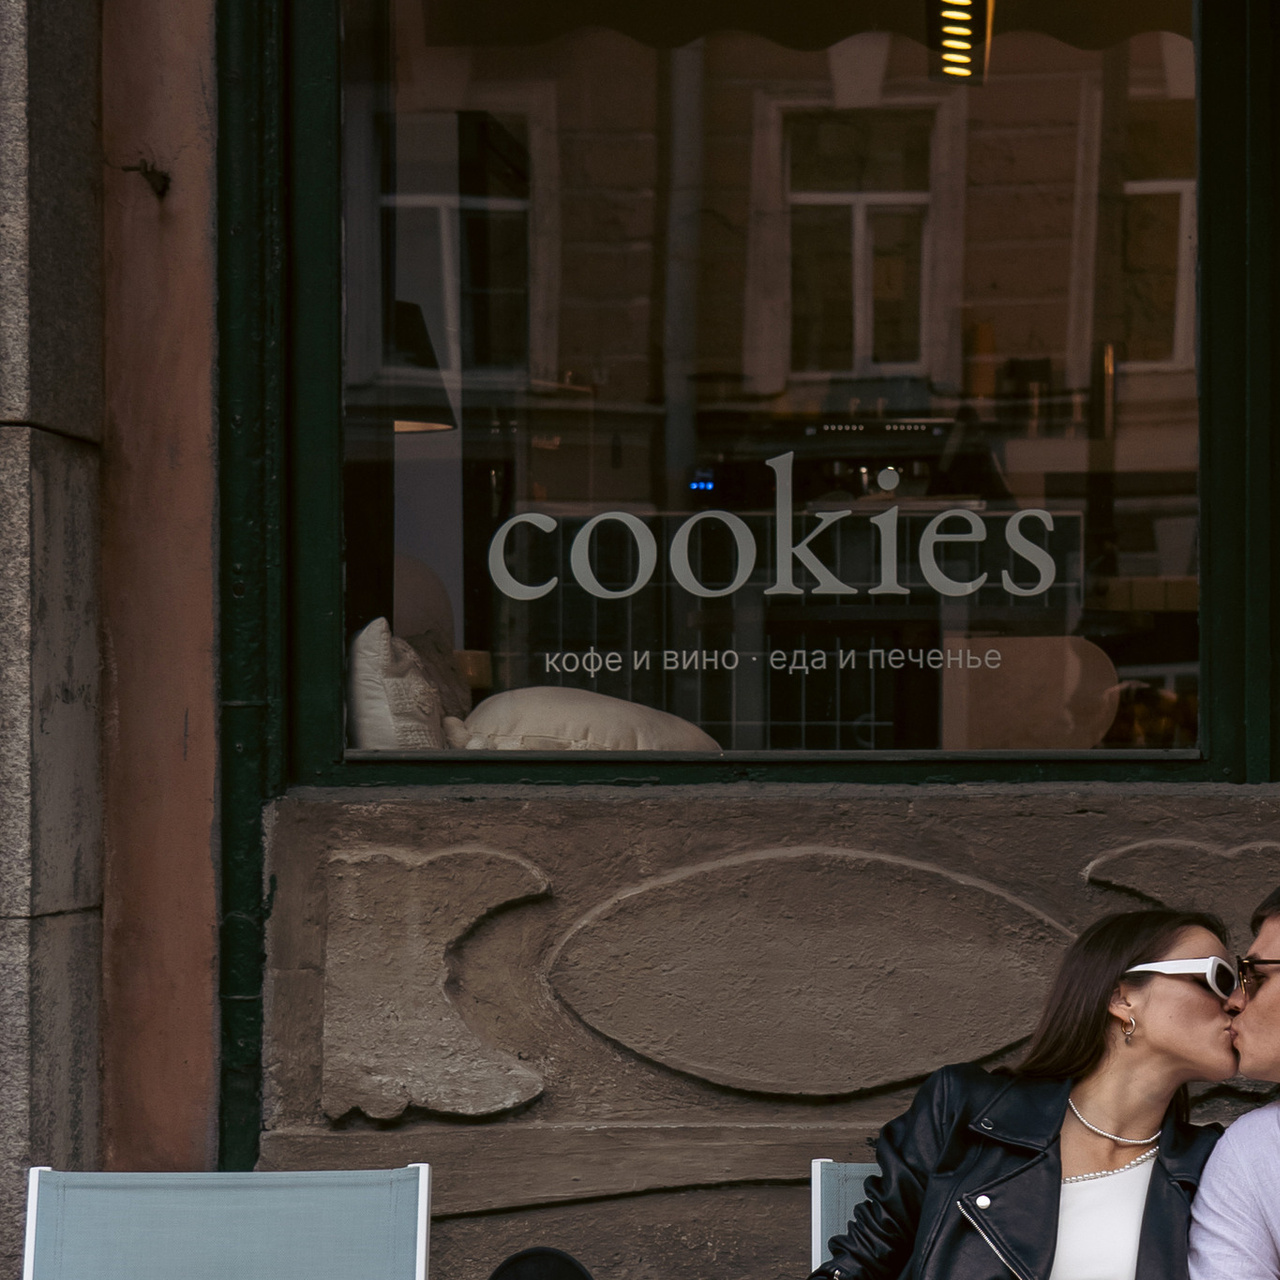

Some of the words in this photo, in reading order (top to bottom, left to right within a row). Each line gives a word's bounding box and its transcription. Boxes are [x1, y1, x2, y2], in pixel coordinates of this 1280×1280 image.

[487, 450, 1057, 600] cookies
[544, 645, 623, 679] кофе
[633, 650, 650, 672] и
[663, 648, 739, 671] вино
[768, 648, 827, 675] еда
[839, 649, 856, 670] и
[868, 648, 1002, 670] печенье
